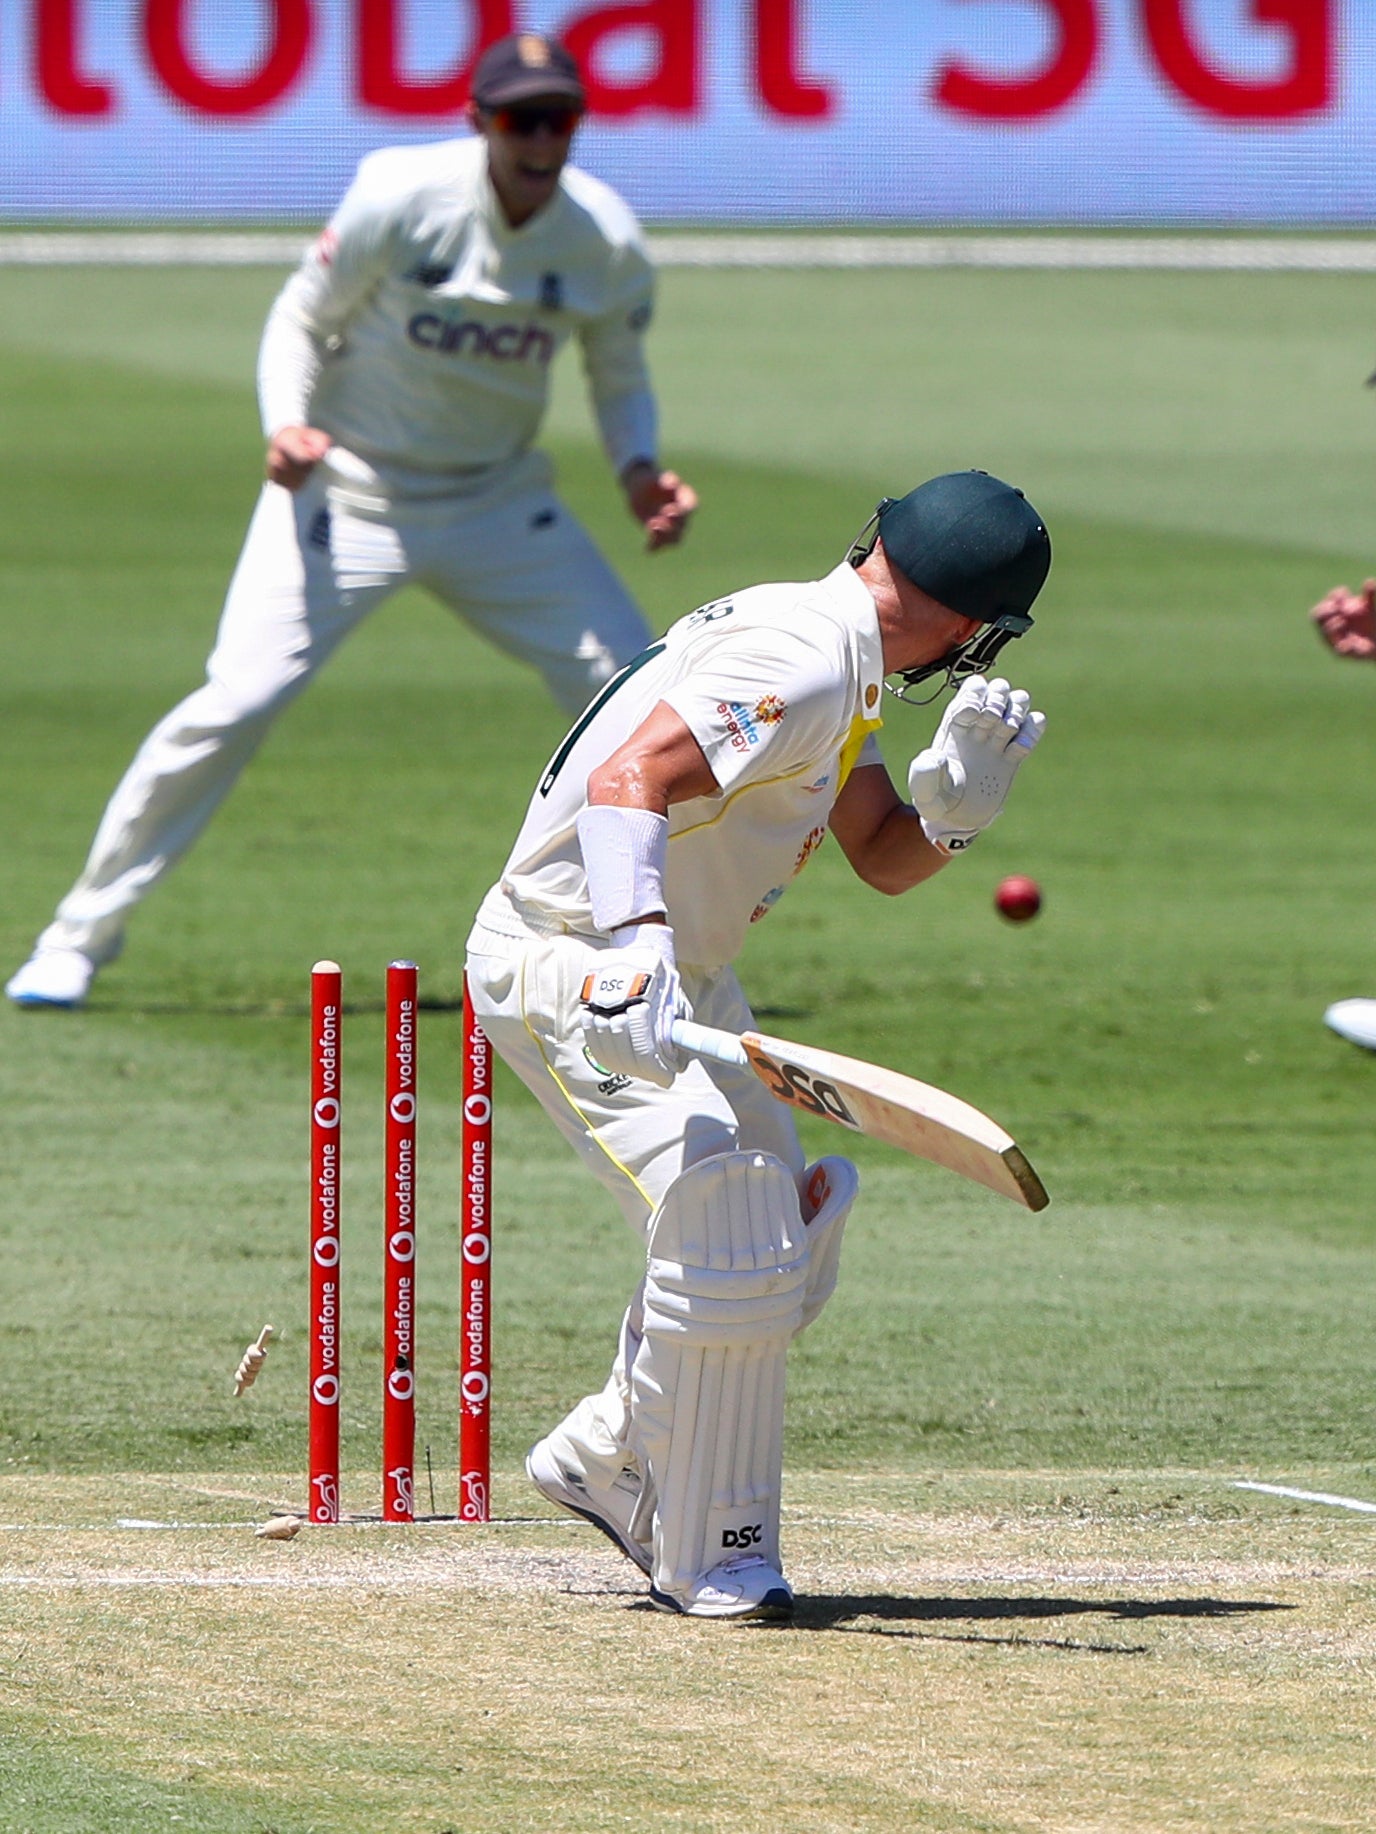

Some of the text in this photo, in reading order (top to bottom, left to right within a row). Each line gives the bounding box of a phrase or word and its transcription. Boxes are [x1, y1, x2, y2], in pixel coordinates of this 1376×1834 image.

[407, 307, 554, 364] cinch
[716, 702, 751, 753] energy
[729, 702, 760, 745] alinta
[600, 979, 624, 991] DSC
[319, 1005, 336, 1093] vodafone
[396, 999, 413, 1088] vodafone
[318, 1143, 335, 1233] vodafone
[395, 1138, 412, 1227] vodafone
[468, 1140, 485, 1229] vodafone
[318, 1281, 335, 1370] vodafone
[467, 1278, 483, 1367] vodafone
[721, 1523, 762, 1549] DSC
